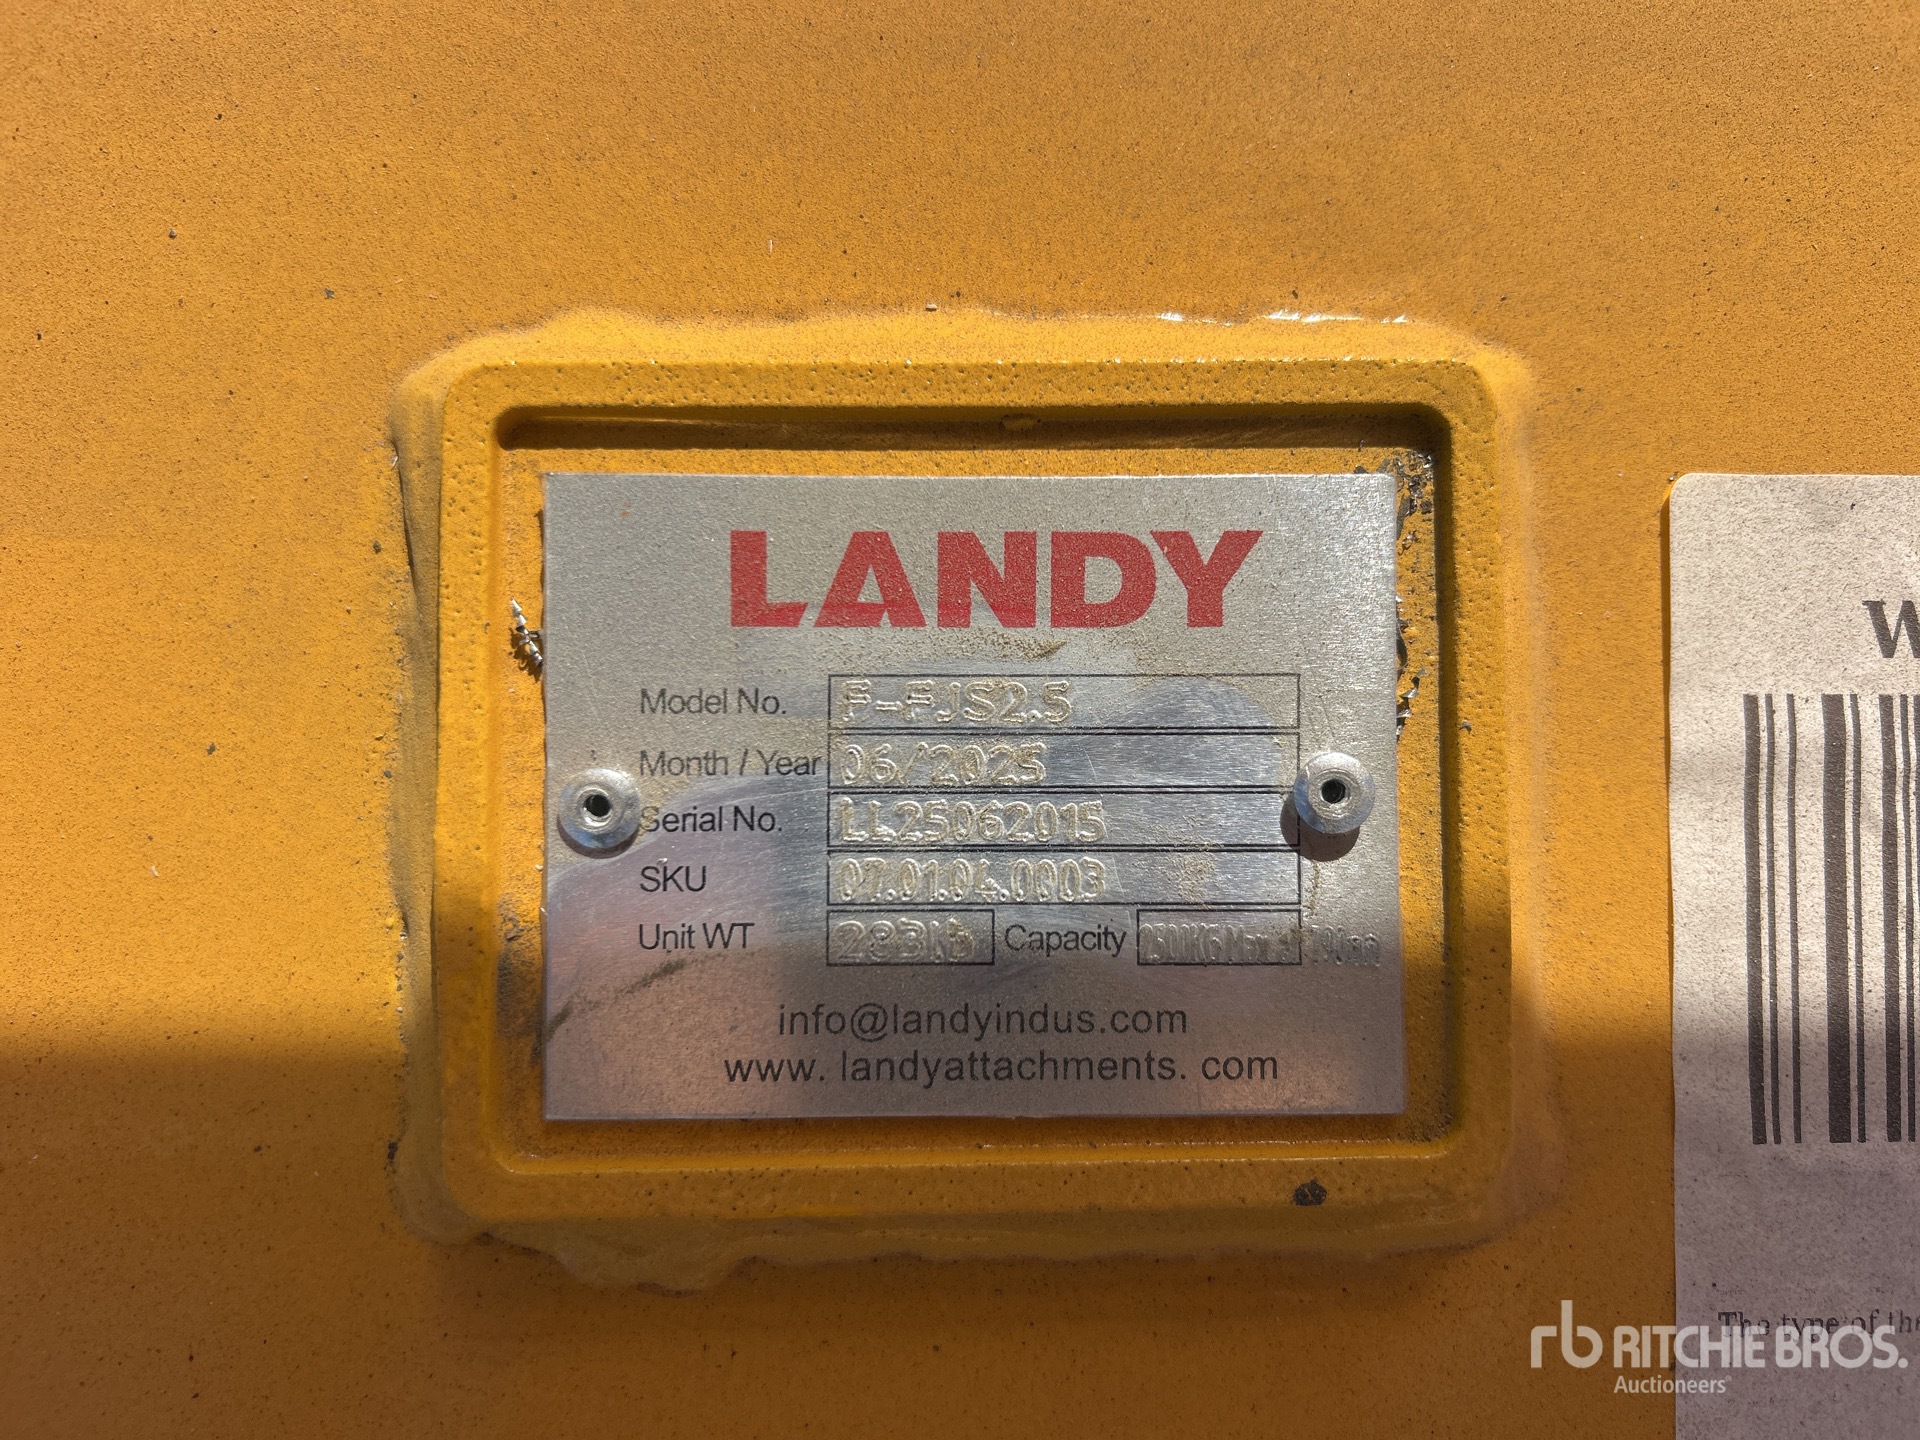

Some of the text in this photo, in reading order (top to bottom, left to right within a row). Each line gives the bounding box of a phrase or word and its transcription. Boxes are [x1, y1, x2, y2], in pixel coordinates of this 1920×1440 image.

[729, 530, 1263, 629] LANDY
[640, 679, 1075, 723] Model No. F-FJS2.5
[640, 750, 729, 777] Month
[756, 750, 823, 776] Year
[841, 741, 1048, 786] 06/2025
[640, 797, 1109, 843] Serial No. LL25062015
[640, 865, 707, 892] SKU
[639, 922, 696, 950] Unit
[702, 922, 756, 949] WT
[1004, 923, 1128, 958] Capacity
[777, 1002, 1189, 1043] info@landyindus.com
[723, 1050, 1279, 1090] www. landyattachments. com
[1851, 1308, 1880, 1335] of
